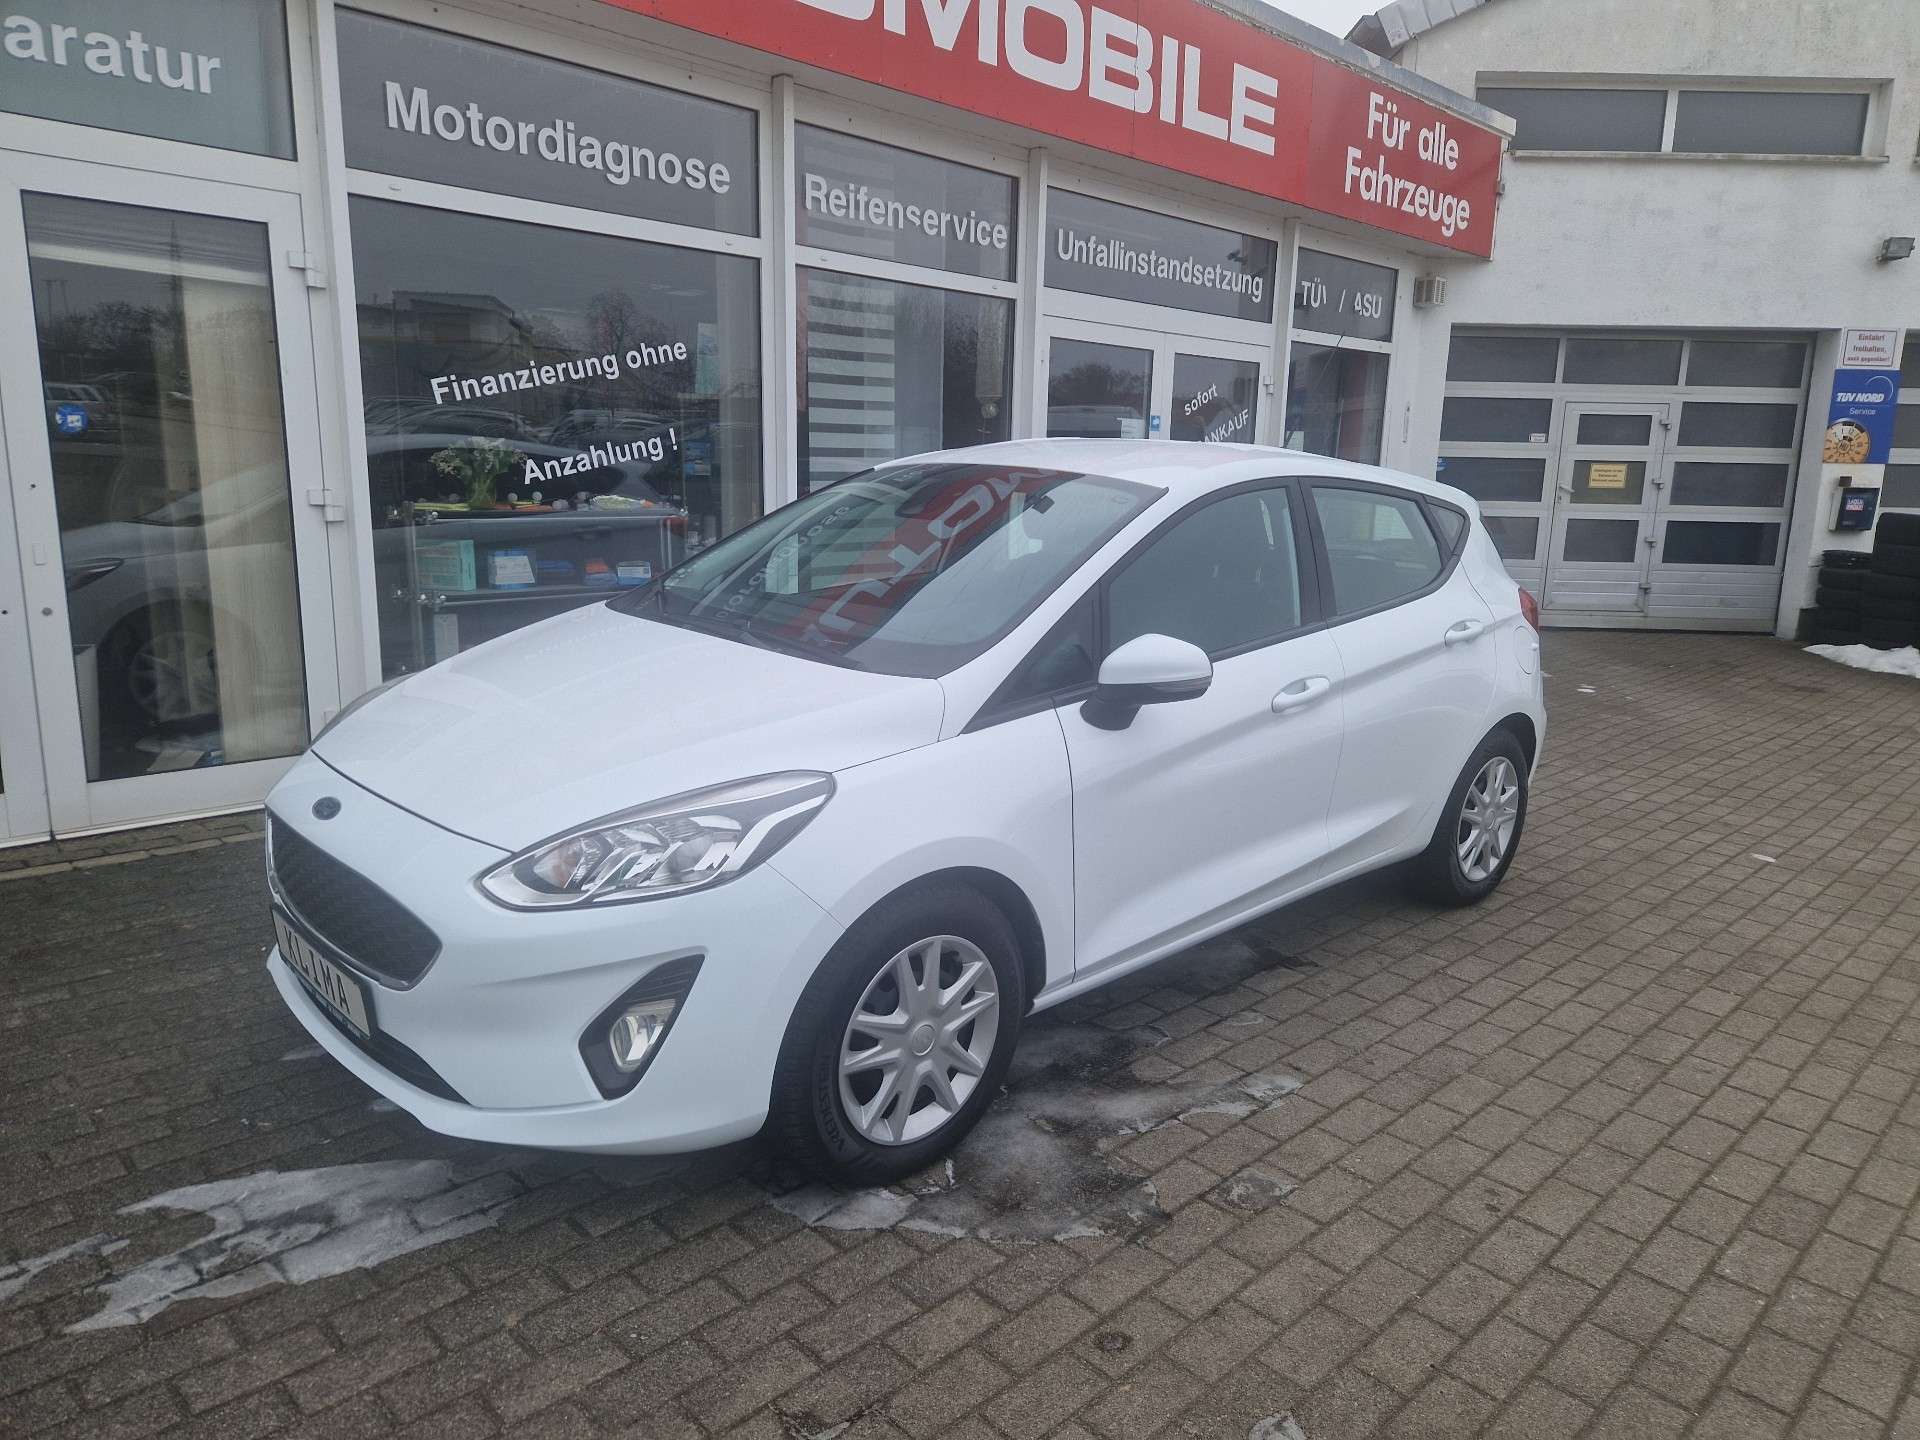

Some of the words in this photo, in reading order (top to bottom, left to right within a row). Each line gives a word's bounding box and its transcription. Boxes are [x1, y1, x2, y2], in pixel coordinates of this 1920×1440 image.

[3, 15, 221, 94] aratur
[796, 0, 1279, 156] MOBILE
[385, 81, 731, 194] Motordiagnose
[1367, 91, 1411, 151] Für
[1418, 121, 1459, 170] alle
[804, 172, 1009, 249] Reifenservice
[1344, 145, 1470, 237] Fahrzeuge
[1056, 228, 1264, 303] Unfallinstandsetzung
[430, 353, 620, 405] Finanzierung
[625, 341, 688, 370] ohne
[1184, 383, 1218, 416] sofort
[1849, 407, 1877, 415] Service
[1855, 392, 1885, 403] NORD
[523, 437, 664, 485] Anzahlung
[668, 427, 679, 451] !
[283, 925, 350, 1015] KLIMA
